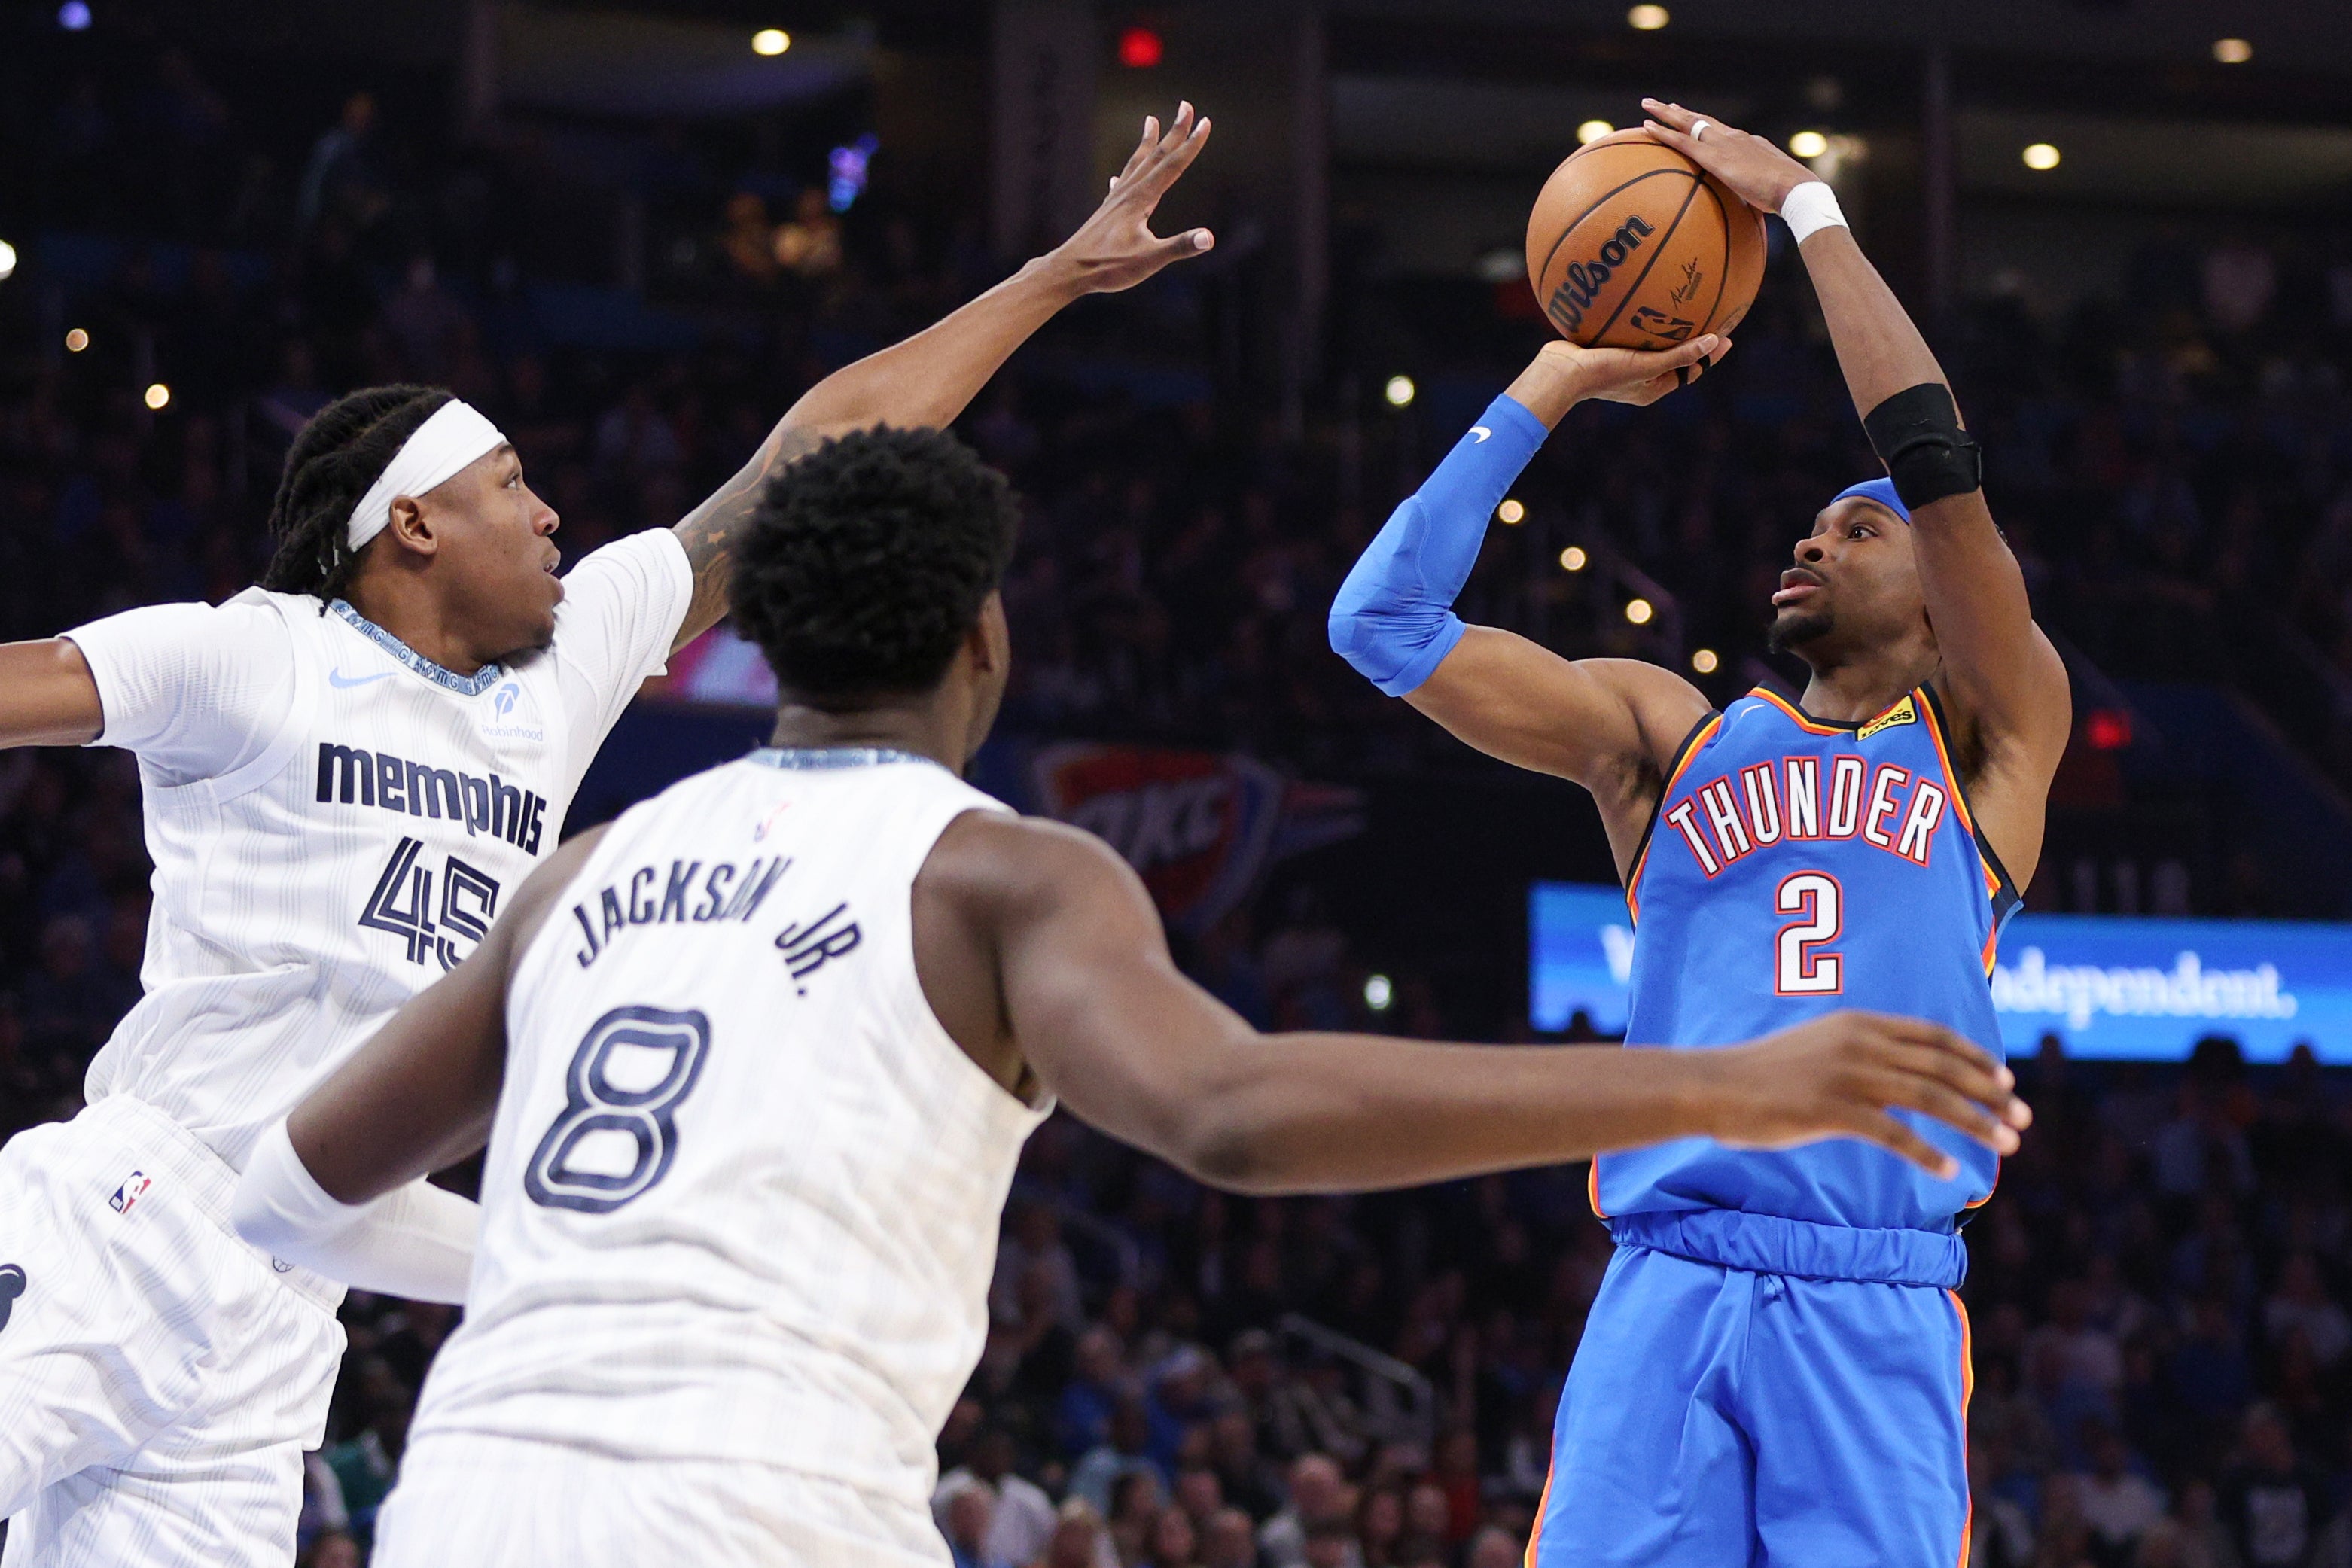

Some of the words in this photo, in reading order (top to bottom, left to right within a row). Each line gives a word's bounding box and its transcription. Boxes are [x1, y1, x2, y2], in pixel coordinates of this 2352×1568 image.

[1549, 215, 1654, 332] Wilson
[482, 725, 543, 741] Robinhood
[1663, 754, 1947, 880] THUNDER
[358, 836, 500, 972] 45
[775, 903, 861, 996] JR.
[1775, 870, 1843, 996] 2
[525, 1005, 711, 1213] 8
